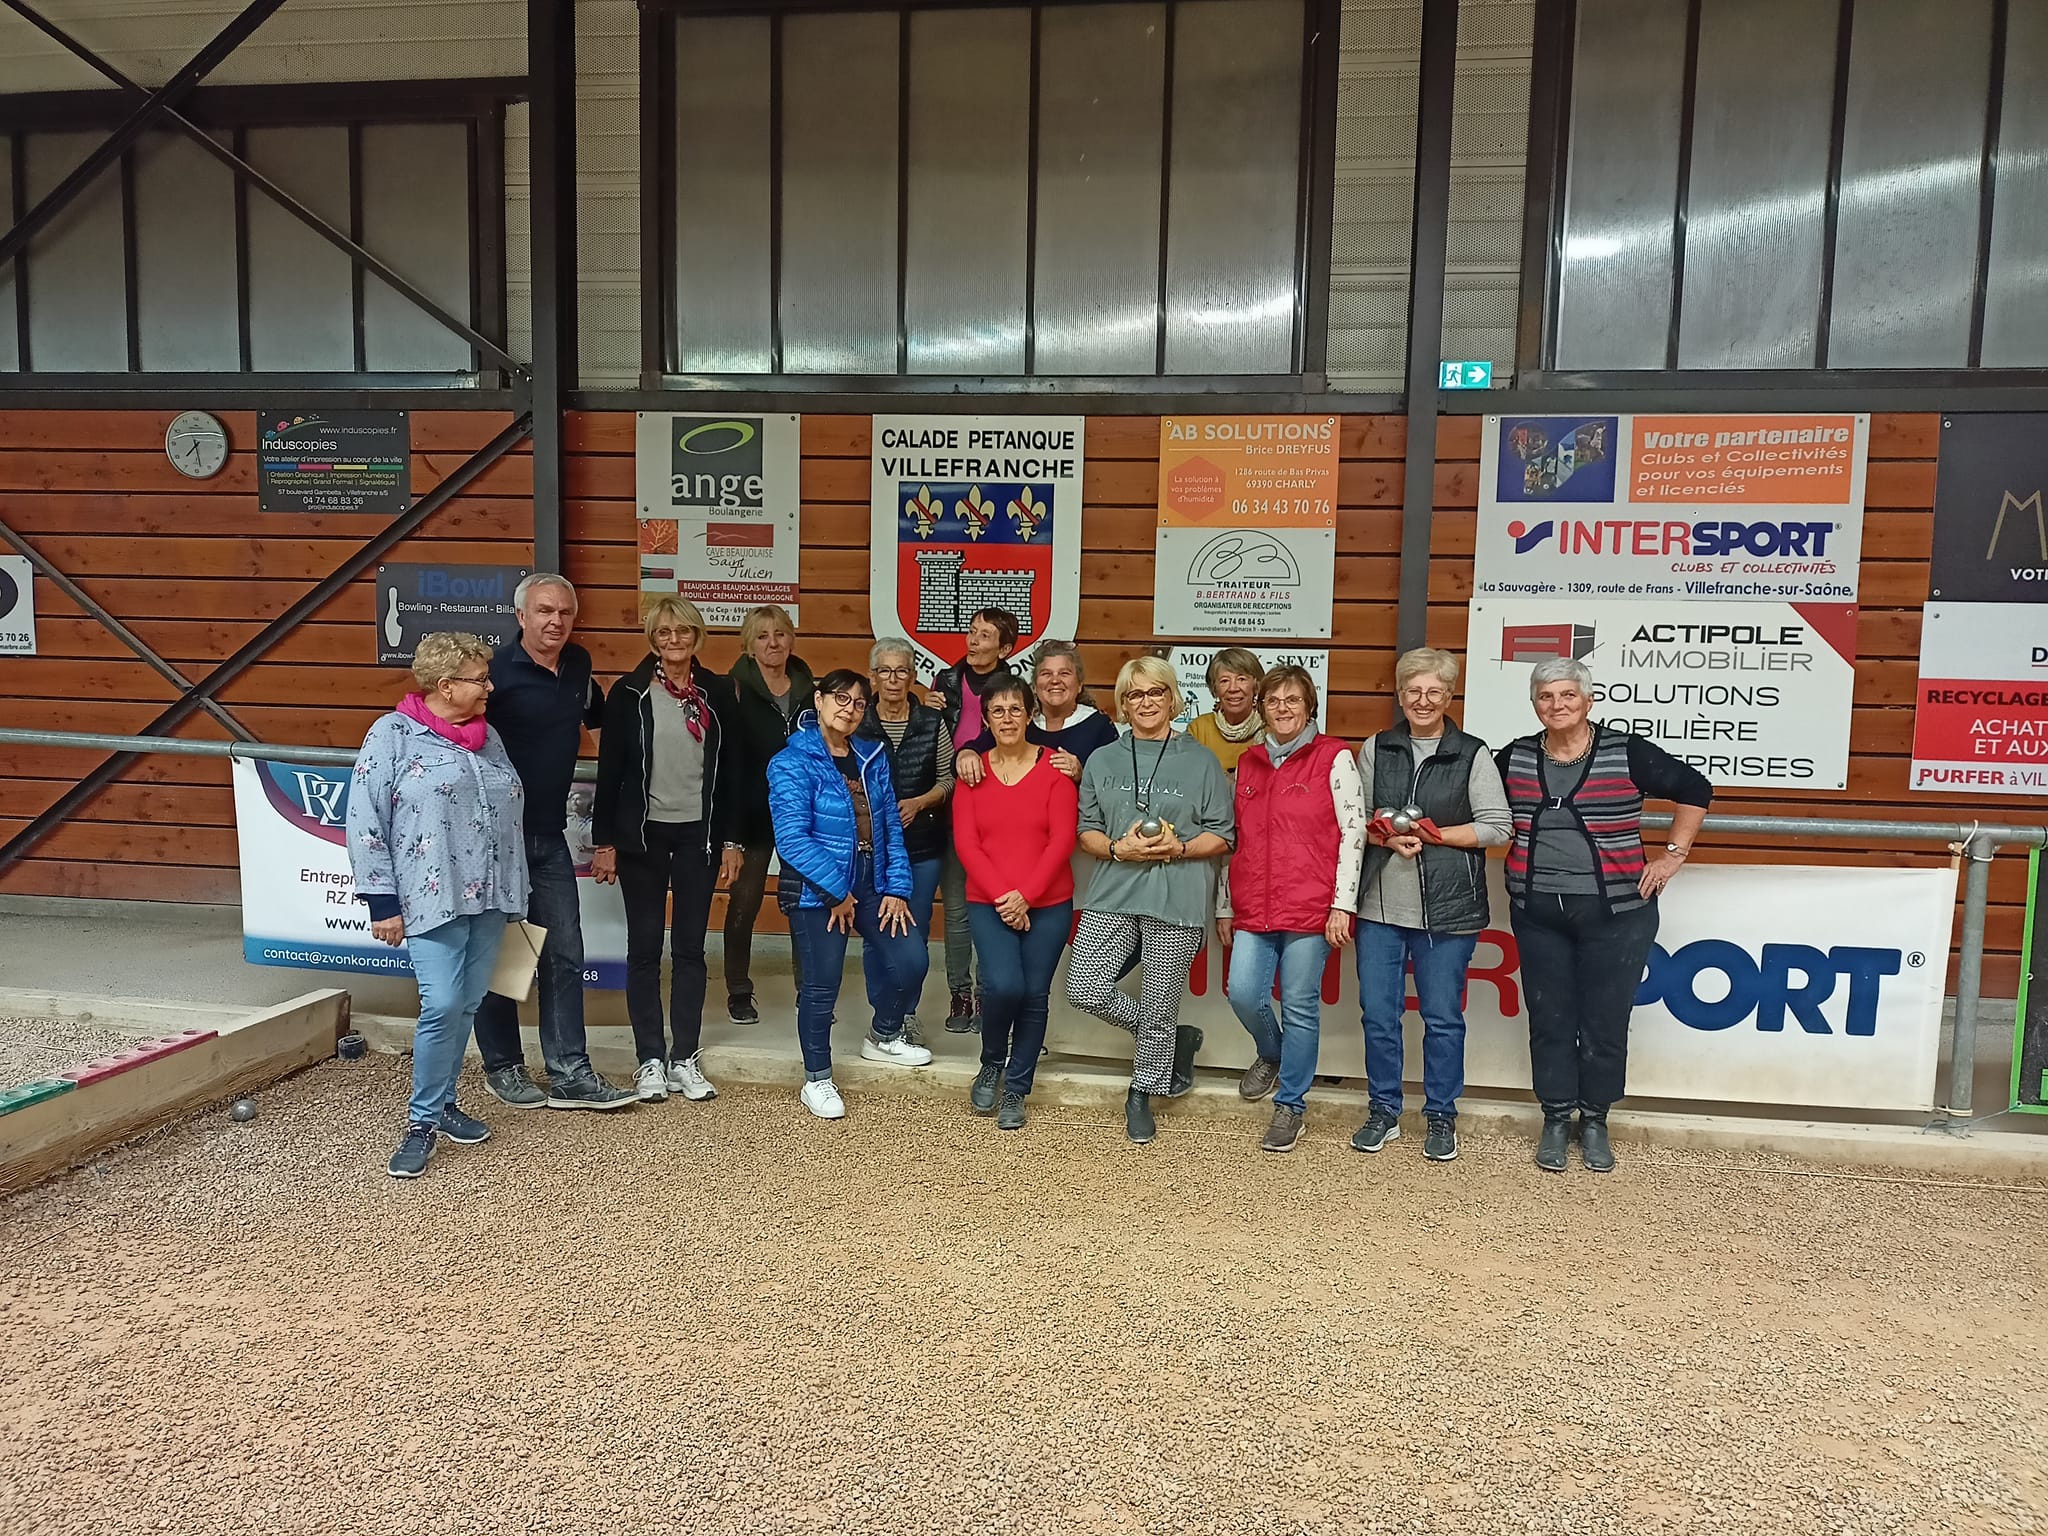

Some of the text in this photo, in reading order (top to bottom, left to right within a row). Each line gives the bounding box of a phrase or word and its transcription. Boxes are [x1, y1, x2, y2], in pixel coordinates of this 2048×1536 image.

[320, 427, 397, 435] www.induscopies.fr
[1169, 423, 1332, 440] AB SOLUTIONS
[1643, 425, 1849, 449] Votre partenaire
[262, 439, 337, 452] Induscopies
[881, 429, 1074, 451] CALADE PETANQUE
[1245, 444, 1331, 455] Brice DREYFUS
[1641, 446, 1848, 465] Clubs et Collectivités
[301, 456, 342, 464] d'impression
[881, 458, 1074, 478] VILLEFRANCHE
[1234, 467, 1329, 476] 1286 route de Bas Privas
[1638, 463, 1843, 483] pour vos équipements
[1174, 475, 1183, 483] La
[1184, 475, 1213, 483] solution
[1246, 480, 1316, 489] 69390 CHARLY
[672, 473, 763, 507] ange
[1184, 485, 1222, 496] problèmes
[1636, 481, 1745, 496] et licenciés
[340, 497, 351, 505] 83
[353, 497, 364, 505] 36
[1232, 499, 1330, 515] 06 34 43 70 76
[709, 507, 763, 518] Boulangerie
[706, 548, 774, 558] CAVE BEAUJOLAISE
[709, 555, 744, 567] Saint
[1671, 560, 1837, 574] CLUBS ET COLLECTIVITÉS
[728, 566, 773, 579] Julien
[417, 570, 504, 598] iBowl
[683, 583, 720, 591] BEAUJOLAIS
[1216, 581, 1271, 589] TRAITEUR
[1483, 582, 1495, 592] La
[1498, 581, 1556, 595] Sauvagère
[1567, 583, 1594, 594] 1309,
[1597, 583, 1625, 593] route
[1628, 583, 1643, 594] de
[1646, 584, 1674, 594] Frans
[1685, 581, 1852, 596] Villefranche-sur-Saône
[753, 593, 793, 601] BOURGOGNE
[1270, 591, 1291, 599] FILS
[398, 602, 432, 614] Bowling
[440, 603, 488, 613] Restaurant
[496, 605, 515, 613] Billa
[715, 606, 729, 614] Cep
[1252, 602, 1292, 610] RECEPTIONS
[6, 633, 16, 641] 70
[19, 633, 29, 642] 26
[487, 635, 501, 646] 34
[1631, 624, 1804, 645] ACTIPOLE
[1591, 682, 1780, 706] SOLUTIONS
[1927, 690, 2048, 706] RECYCLAGE
[1969, 719, 2048, 736] ACHAT
[1974, 739, 2048, 756] ET AUX
[1673, 754, 1814, 778] PRISES
[1919, 768, 2004, 784] PURFER
[2009, 771, 2018, 786] à
[300, 868, 355, 888] Entrepr
[326, 890, 347, 905] RZ
[325, 917, 371, 931] www.
[582, 970, 599, 981] 68
